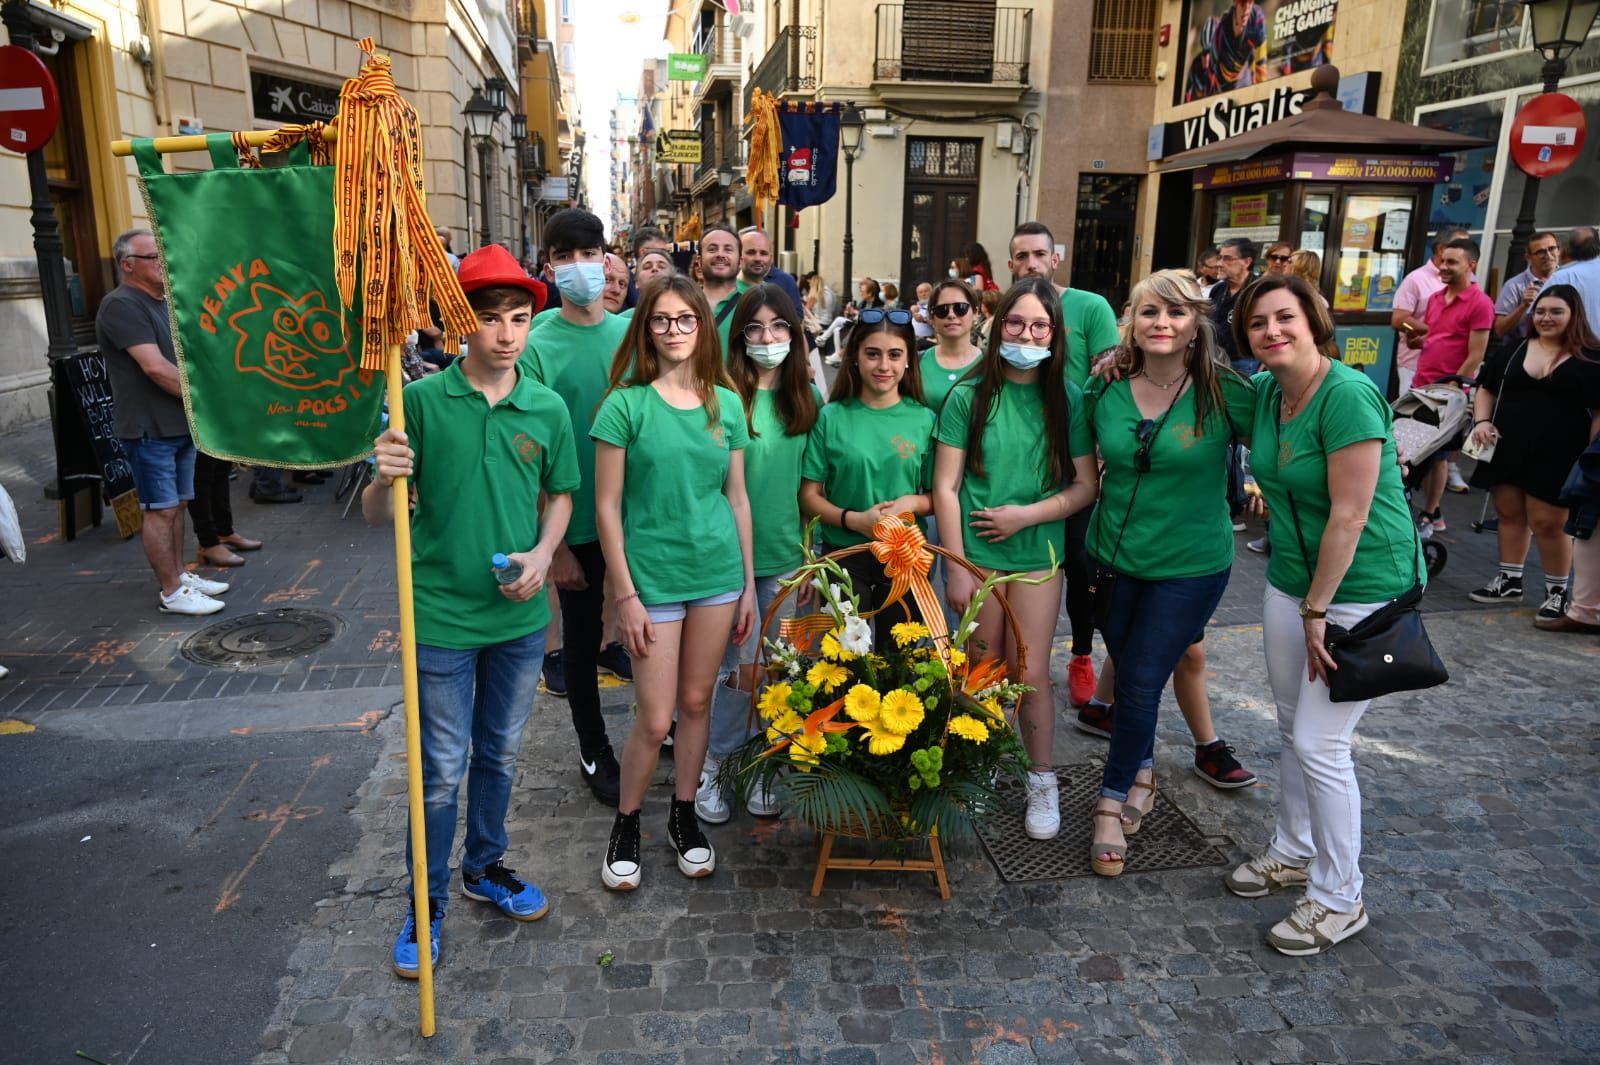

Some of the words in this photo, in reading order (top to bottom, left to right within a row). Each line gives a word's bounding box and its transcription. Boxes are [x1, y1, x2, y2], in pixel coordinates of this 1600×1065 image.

[1273, 19, 1296, 40] THE
[1296, 5, 1334, 32] GAME
[199, 258, 271, 335] PENYA
[1345, 337, 1380, 350] BIEN
[79, 356, 107, 381] HOY
[1344, 350, 1378, 365] JUGADO
